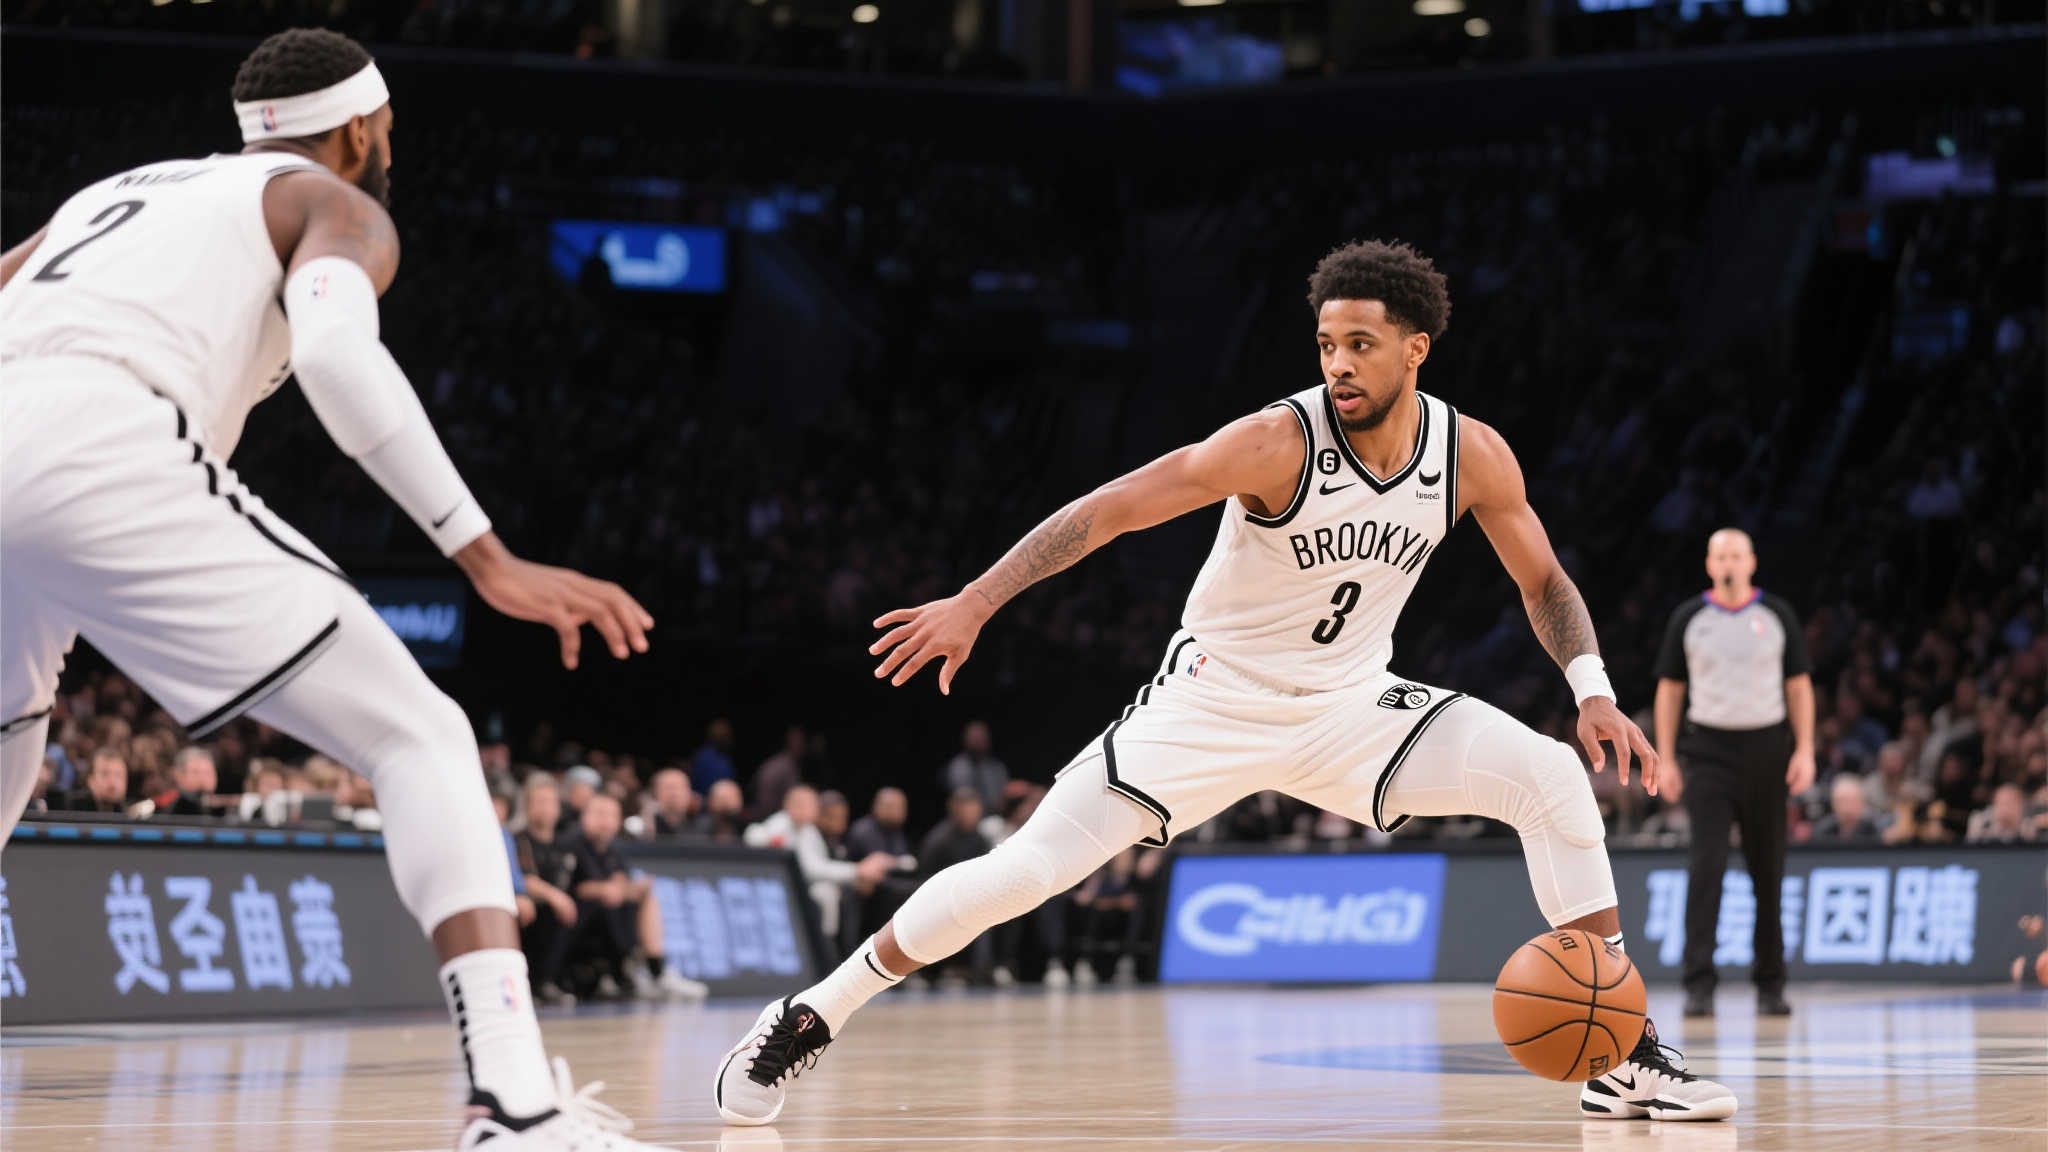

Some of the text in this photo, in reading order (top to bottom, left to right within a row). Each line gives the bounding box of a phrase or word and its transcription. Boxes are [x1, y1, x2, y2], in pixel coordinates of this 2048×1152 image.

[32, 200, 146, 282] 2
[1322, 451, 1336, 472] 6
[1289, 520, 1434, 575] BROOKYN
[1311, 581, 1362, 645] 3
